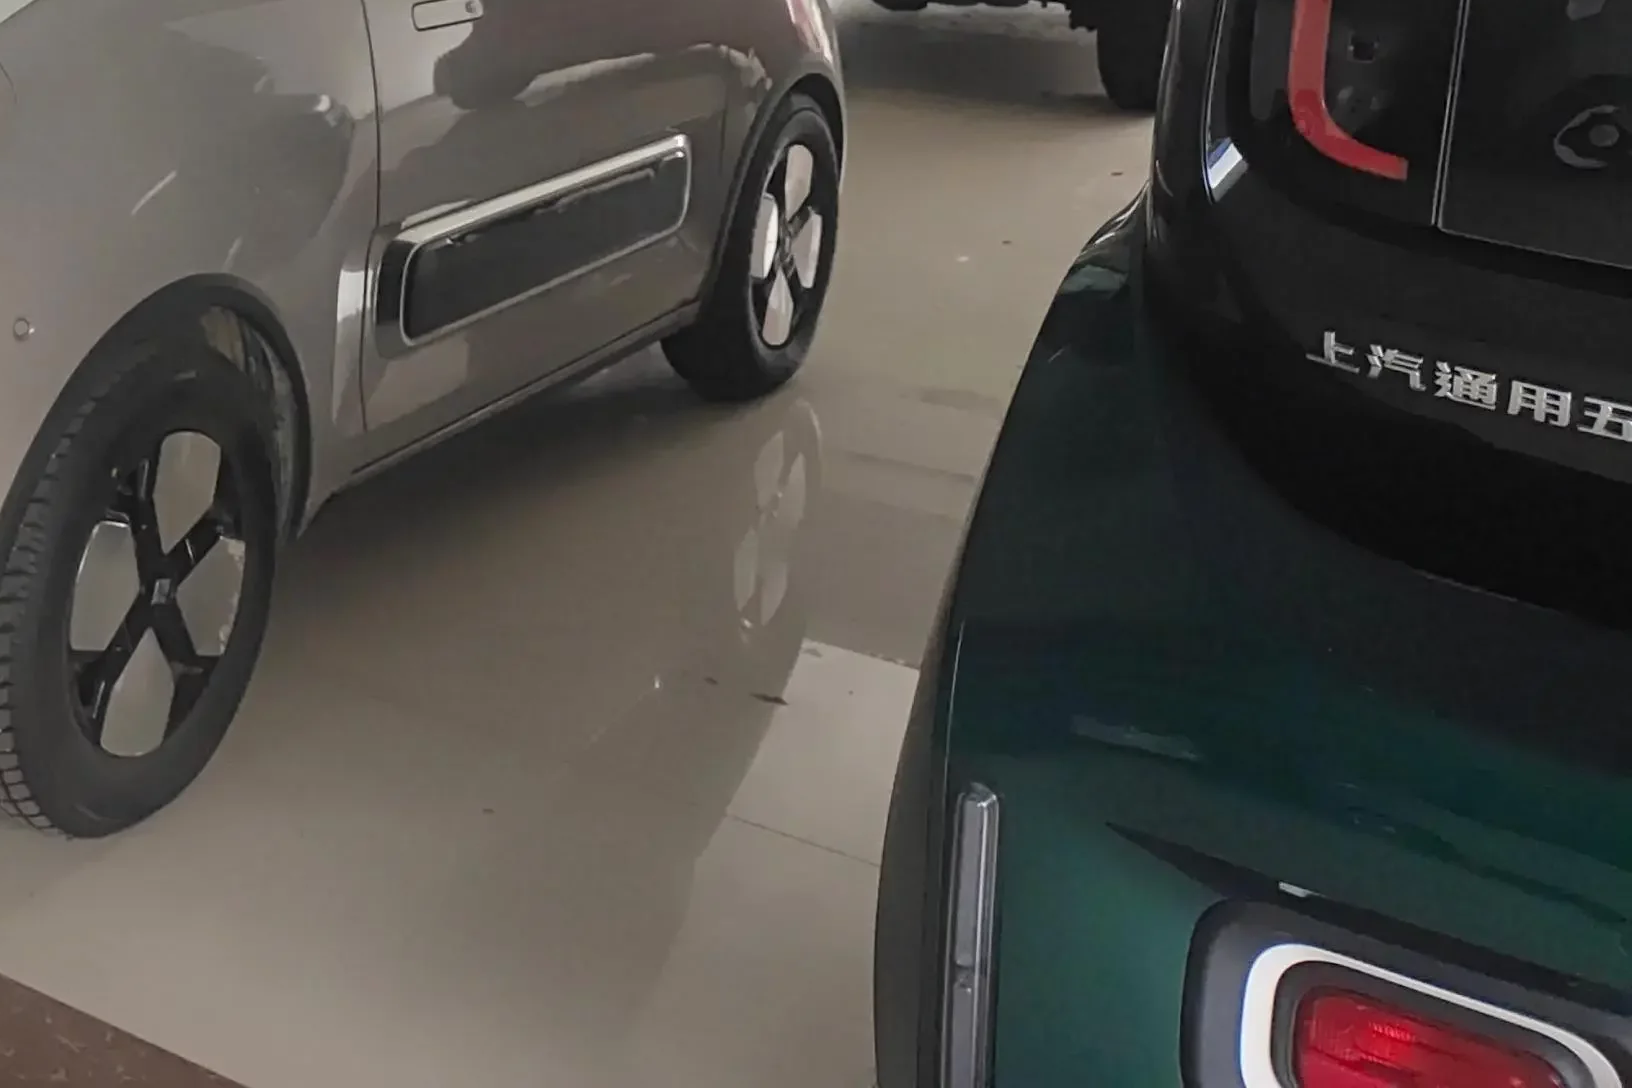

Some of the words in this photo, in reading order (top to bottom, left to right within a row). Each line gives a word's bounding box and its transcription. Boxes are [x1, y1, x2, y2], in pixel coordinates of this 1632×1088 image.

[1305, 330, 1632, 443] 上汽通用五
